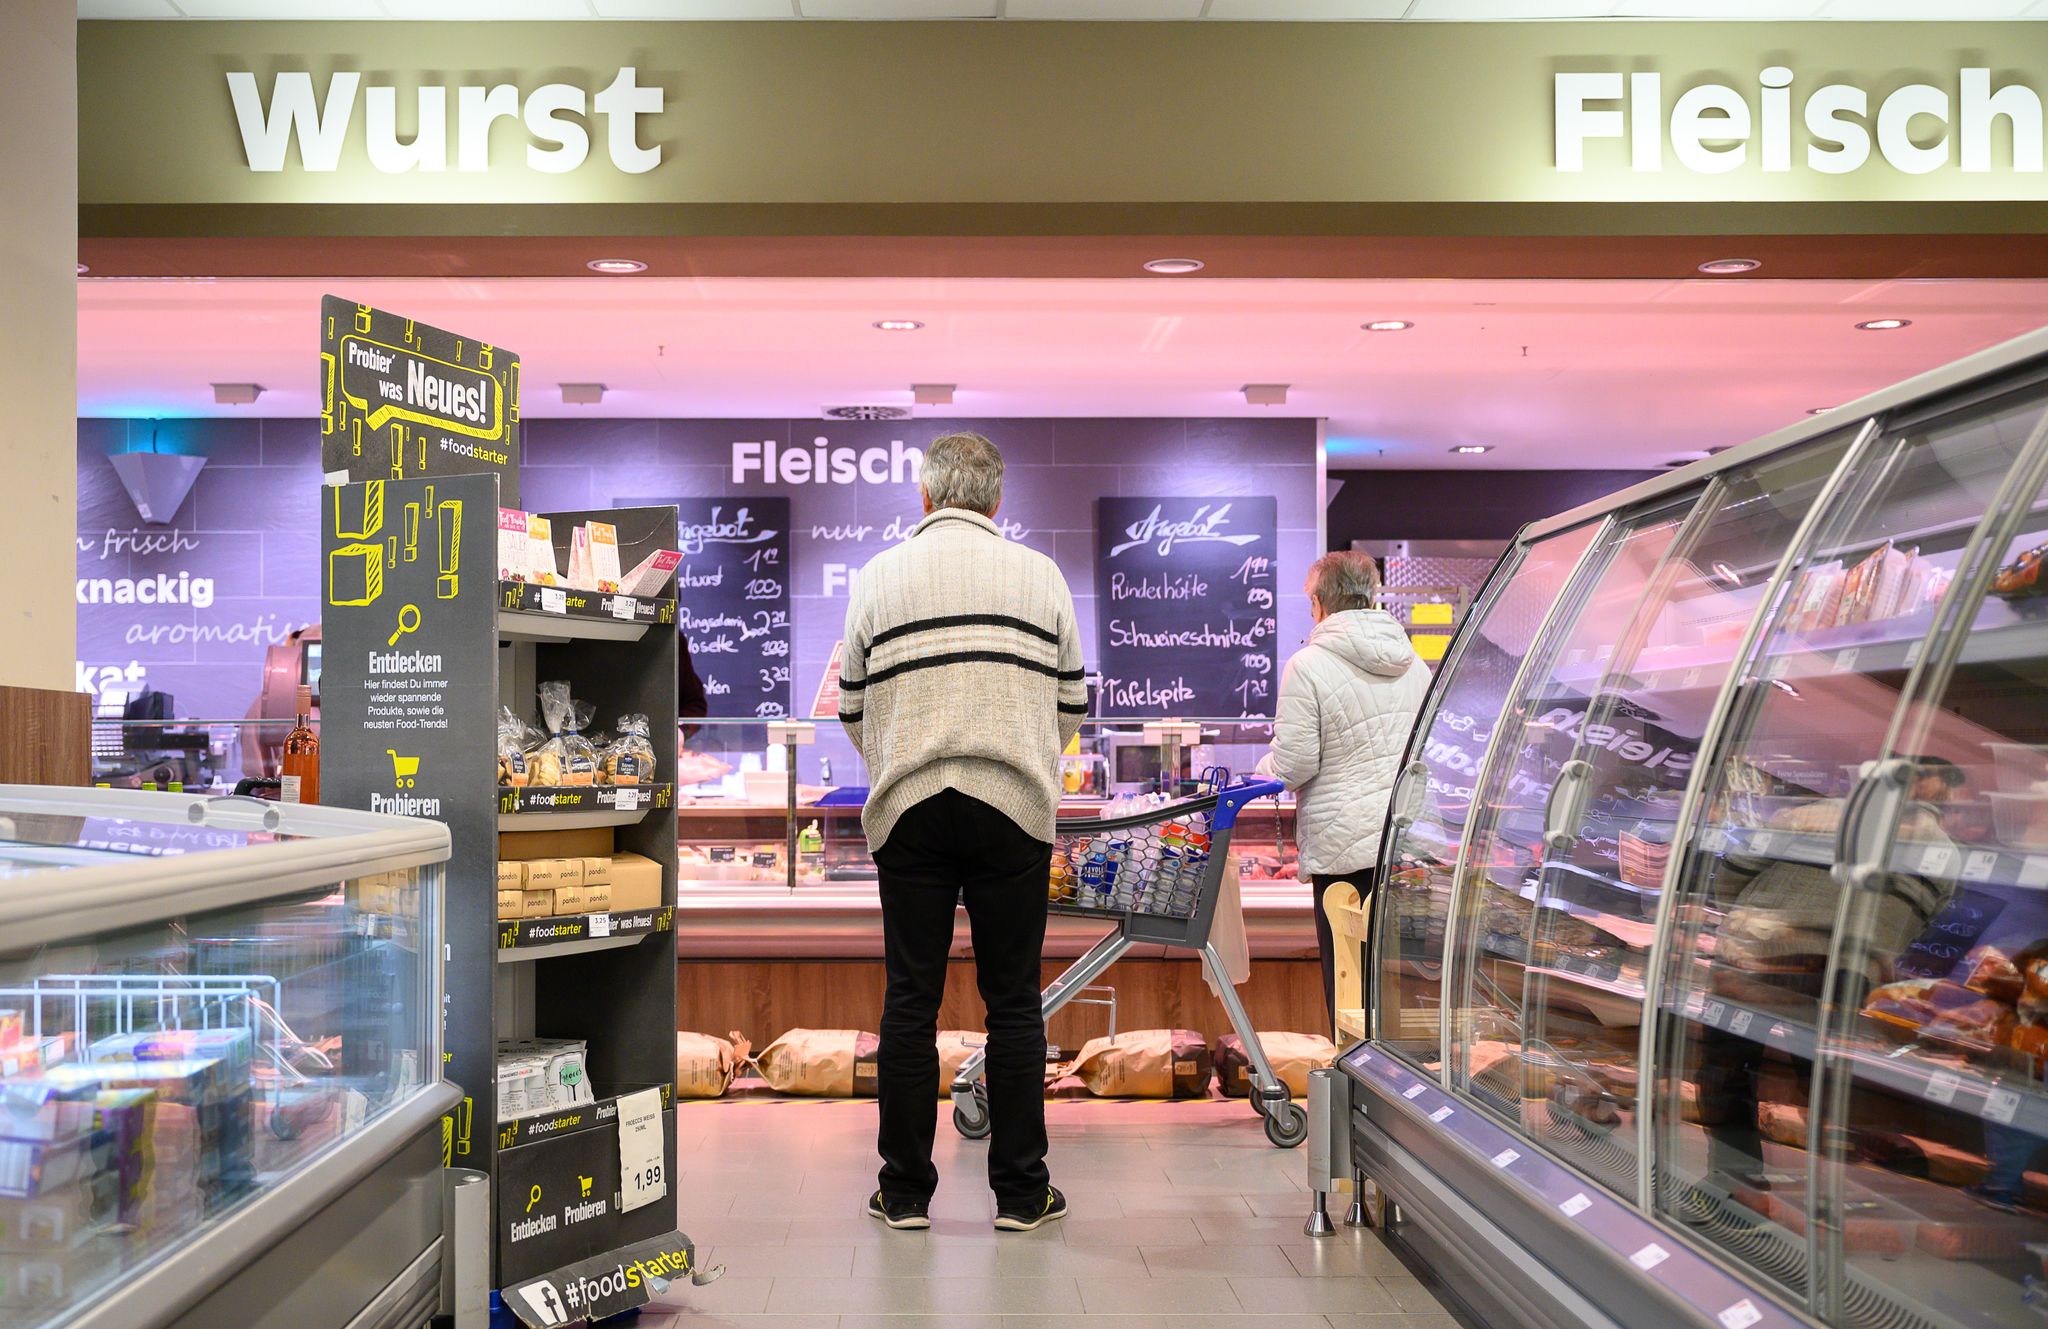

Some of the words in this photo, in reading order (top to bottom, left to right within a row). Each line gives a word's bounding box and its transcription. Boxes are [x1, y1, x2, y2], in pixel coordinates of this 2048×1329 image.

[225, 66, 664, 174] Wurst
[1553, 66, 2044, 174] Fleisch
[379, 380, 403, 402] was
[407, 359, 487, 424] Neues!
[439, 437, 508, 465] #foodstarter
[732, 437, 923, 484] Fleisch
[678, 506, 765, 554] ngebot
[811, 523, 873, 542] nur
[1118, 503, 1240, 556] Angebot
[100, 528, 200, 559] frisch
[369, 651, 442, 674] Entdecken
[364, 679, 380, 689] Hier
[381, 679, 408, 689] findest
[410, 679, 421, 689] Du
[423, 679, 448, 688] immer
[1104, 677, 1196, 709] Tafelspitz
[368, 706, 405, 717] Produkte,
[407, 706, 430, 715] sowie
[431, 706, 444, 715] die
[370, 693, 396, 702] wieder
[398, 692, 441, 704] spannende
[364, 721, 394, 729] neusten
[396, 719, 448, 729] Food-Trends!
[370, 793, 440, 816] Probieren
[530, 793, 582, 806] #foodstarter
[637, 789, 652, 802] eues!
[529, 924, 582, 938] #foodstarter
[621, 918, 633, 929] was
[633, 914, 652, 928] Neues!
[529, 1115, 581, 1136] #foodstarter
[635, 1165, 661, 1191] 1,99
[511, 1213, 557, 1243] Entdecken
[565, 1198, 607, 1226] Probieren
[565, 1249, 689, 1308] #foodstarter
